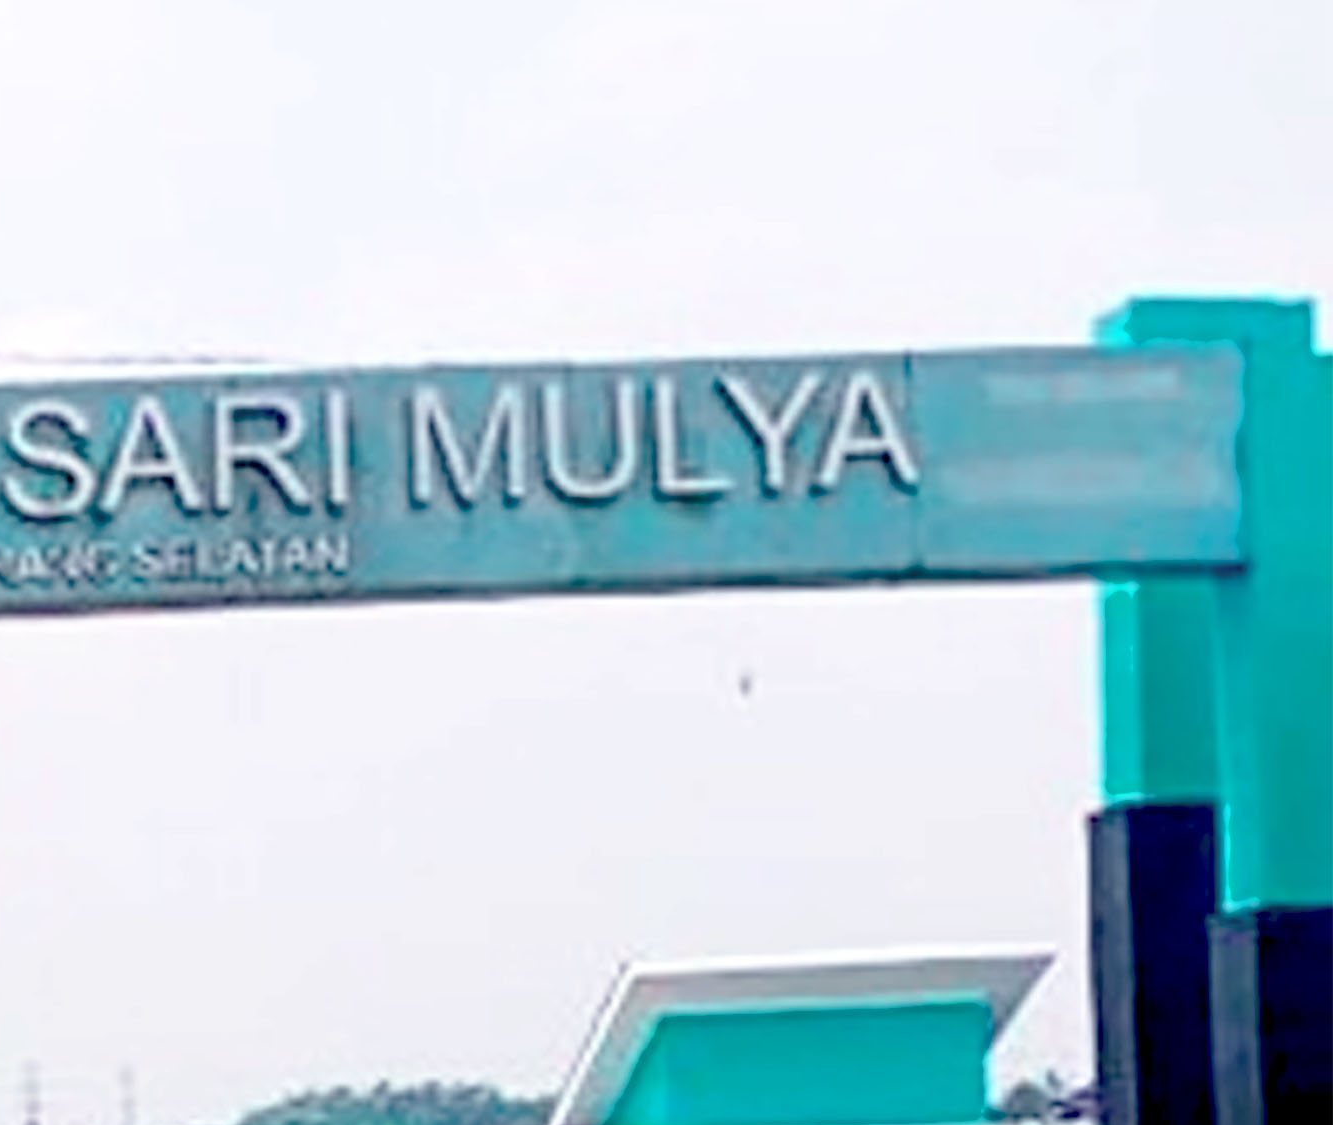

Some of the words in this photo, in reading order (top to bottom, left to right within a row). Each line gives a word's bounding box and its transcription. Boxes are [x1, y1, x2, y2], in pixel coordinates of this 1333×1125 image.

[1, 386, 351, 521] SARI
[407, 369, 920, 511] MULYA
[129, 528, 353, 586] SELATAN
